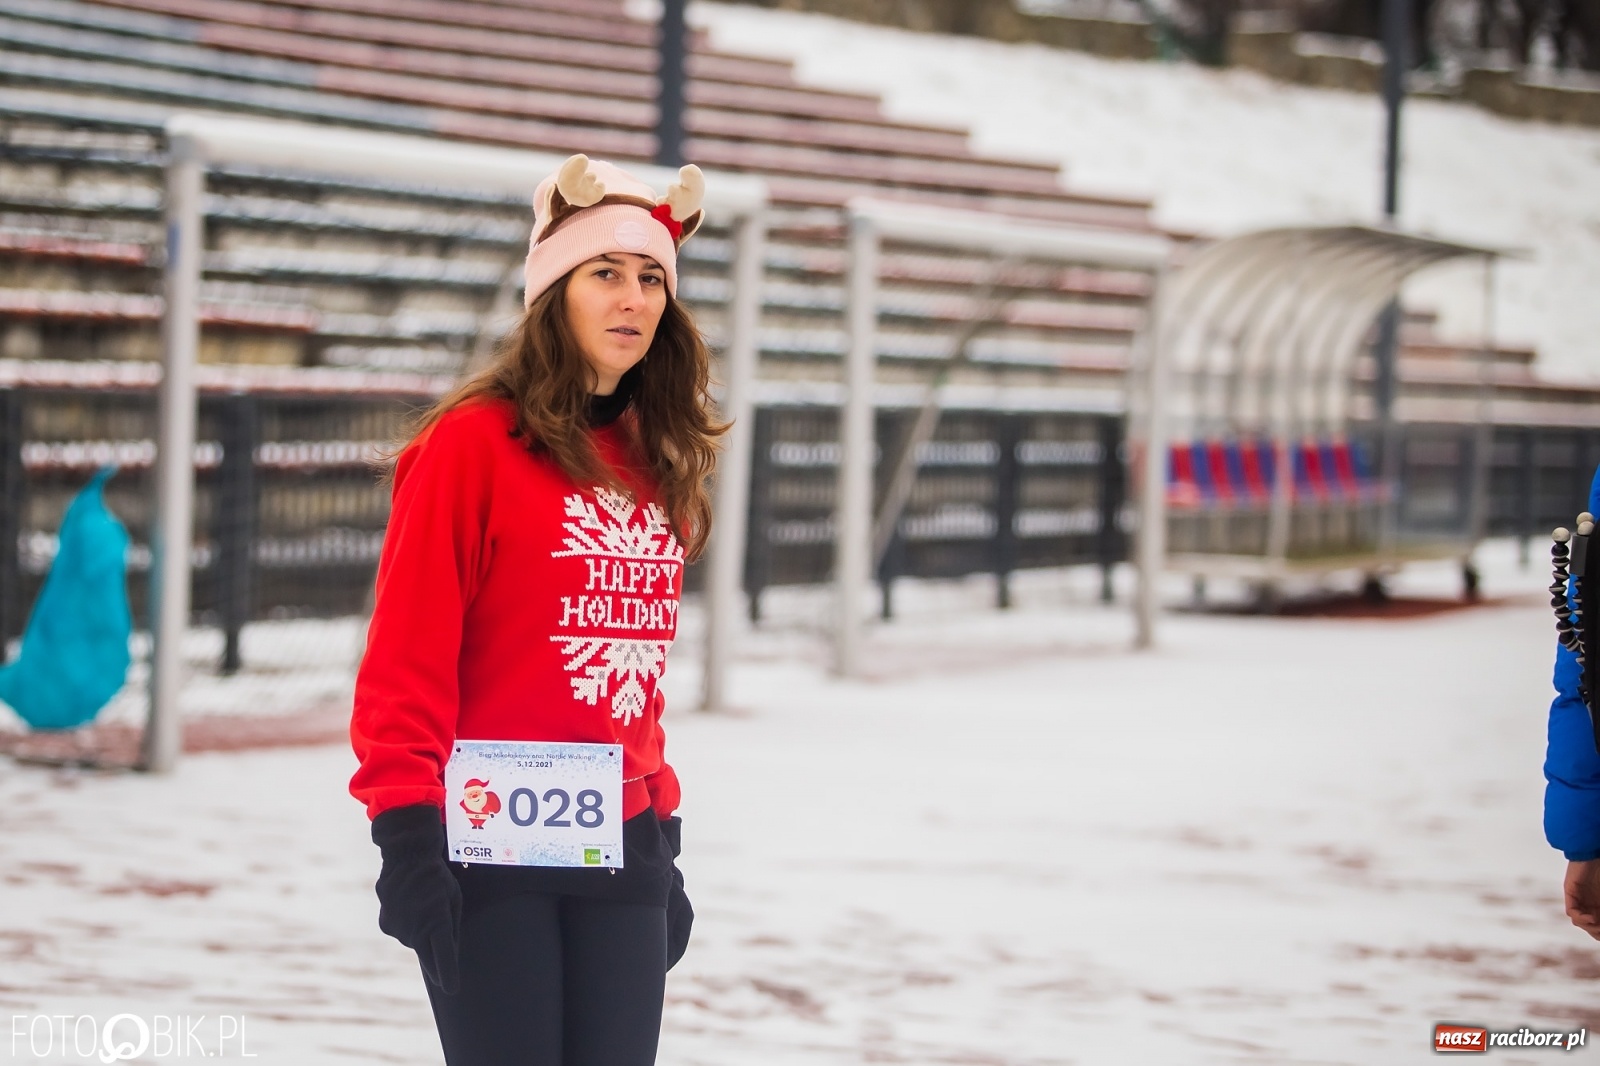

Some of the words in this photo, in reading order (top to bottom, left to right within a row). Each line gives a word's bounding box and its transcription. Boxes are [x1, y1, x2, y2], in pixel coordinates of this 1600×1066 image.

[585, 558, 679, 594] HAPPY
[558, 595, 680, 630] HOLIDAY
[567, 753, 592, 761] Walking
[508, 787, 605, 829] 028
